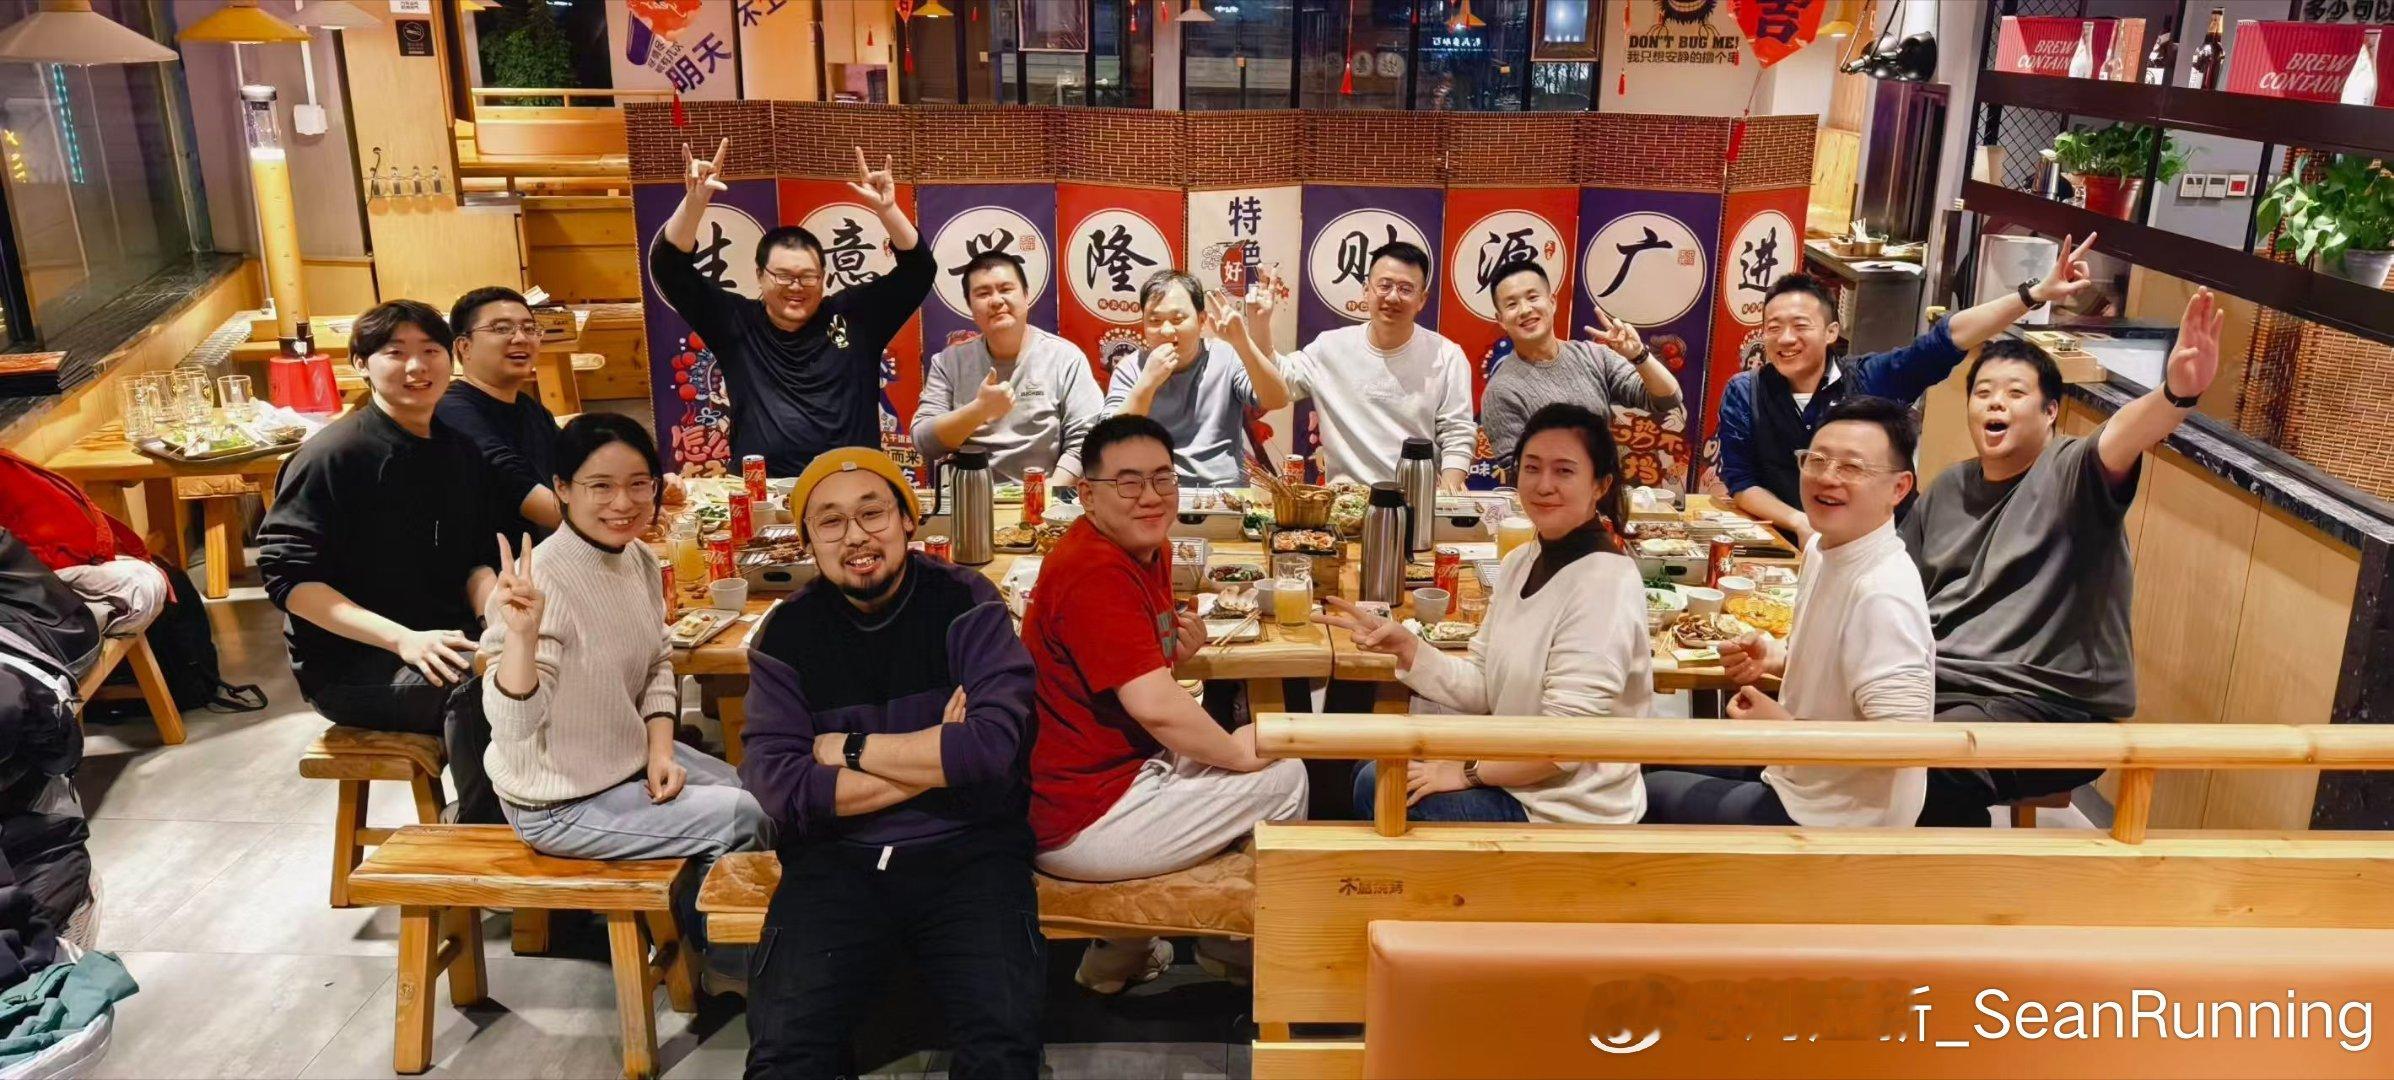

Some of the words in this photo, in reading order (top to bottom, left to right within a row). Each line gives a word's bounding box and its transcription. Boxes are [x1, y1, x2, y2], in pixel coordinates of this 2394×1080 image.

[1629, 35, 1674, 49] DON'T
[1679, 35, 1707, 49] BUG
[1712, 35, 1740, 50] ME!
[2033, 39, 2080, 55] BREW
[665, 32, 731, 94] 明天
[2286, 52, 2354, 72] BREW
[1086, 224, 1158, 293] 隆
[1597, 226, 1674, 298] 广
[1224, 260, 1243, 283] 好
